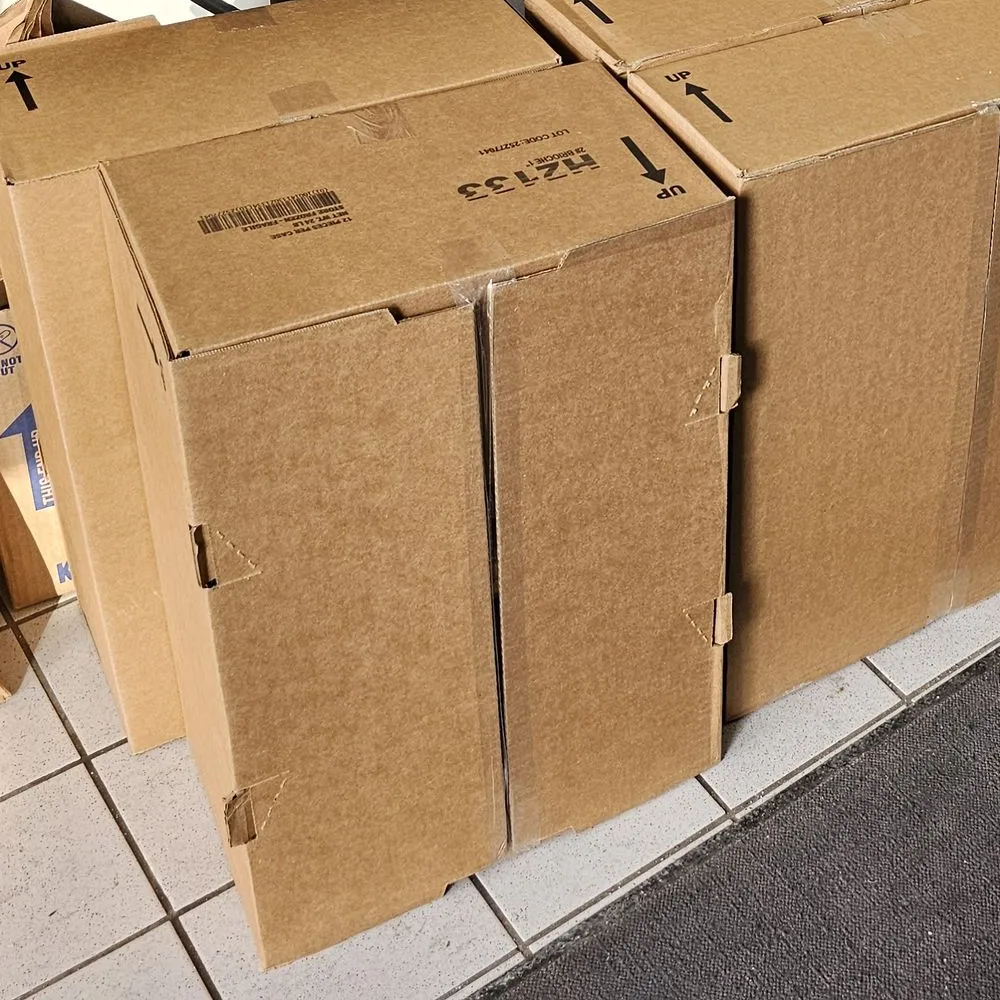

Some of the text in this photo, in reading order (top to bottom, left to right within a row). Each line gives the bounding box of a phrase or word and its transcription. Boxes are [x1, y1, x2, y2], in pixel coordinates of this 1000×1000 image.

[0, 60, 27, 70] UP
[664, 71, 691, 83] UP
[551, 128, 570, 139] LOT
[537, 149, 575, 164] BRIOCHE
[457, 153, 600, 202] H2133
[656, 184, 687, 200] UP
[318, 204, 345, 214] STORE
[332, 210, 350, 219] NET
[284, 209, 318, 223] FROZEN
[241, 219, 279, 233] FRAGILE
[313, 218, 341, 230] PIECES
[271, 230, 294, 240] CASE
[296, 226, 312, 235] PER
[1, 355, 22, 368] NOT
